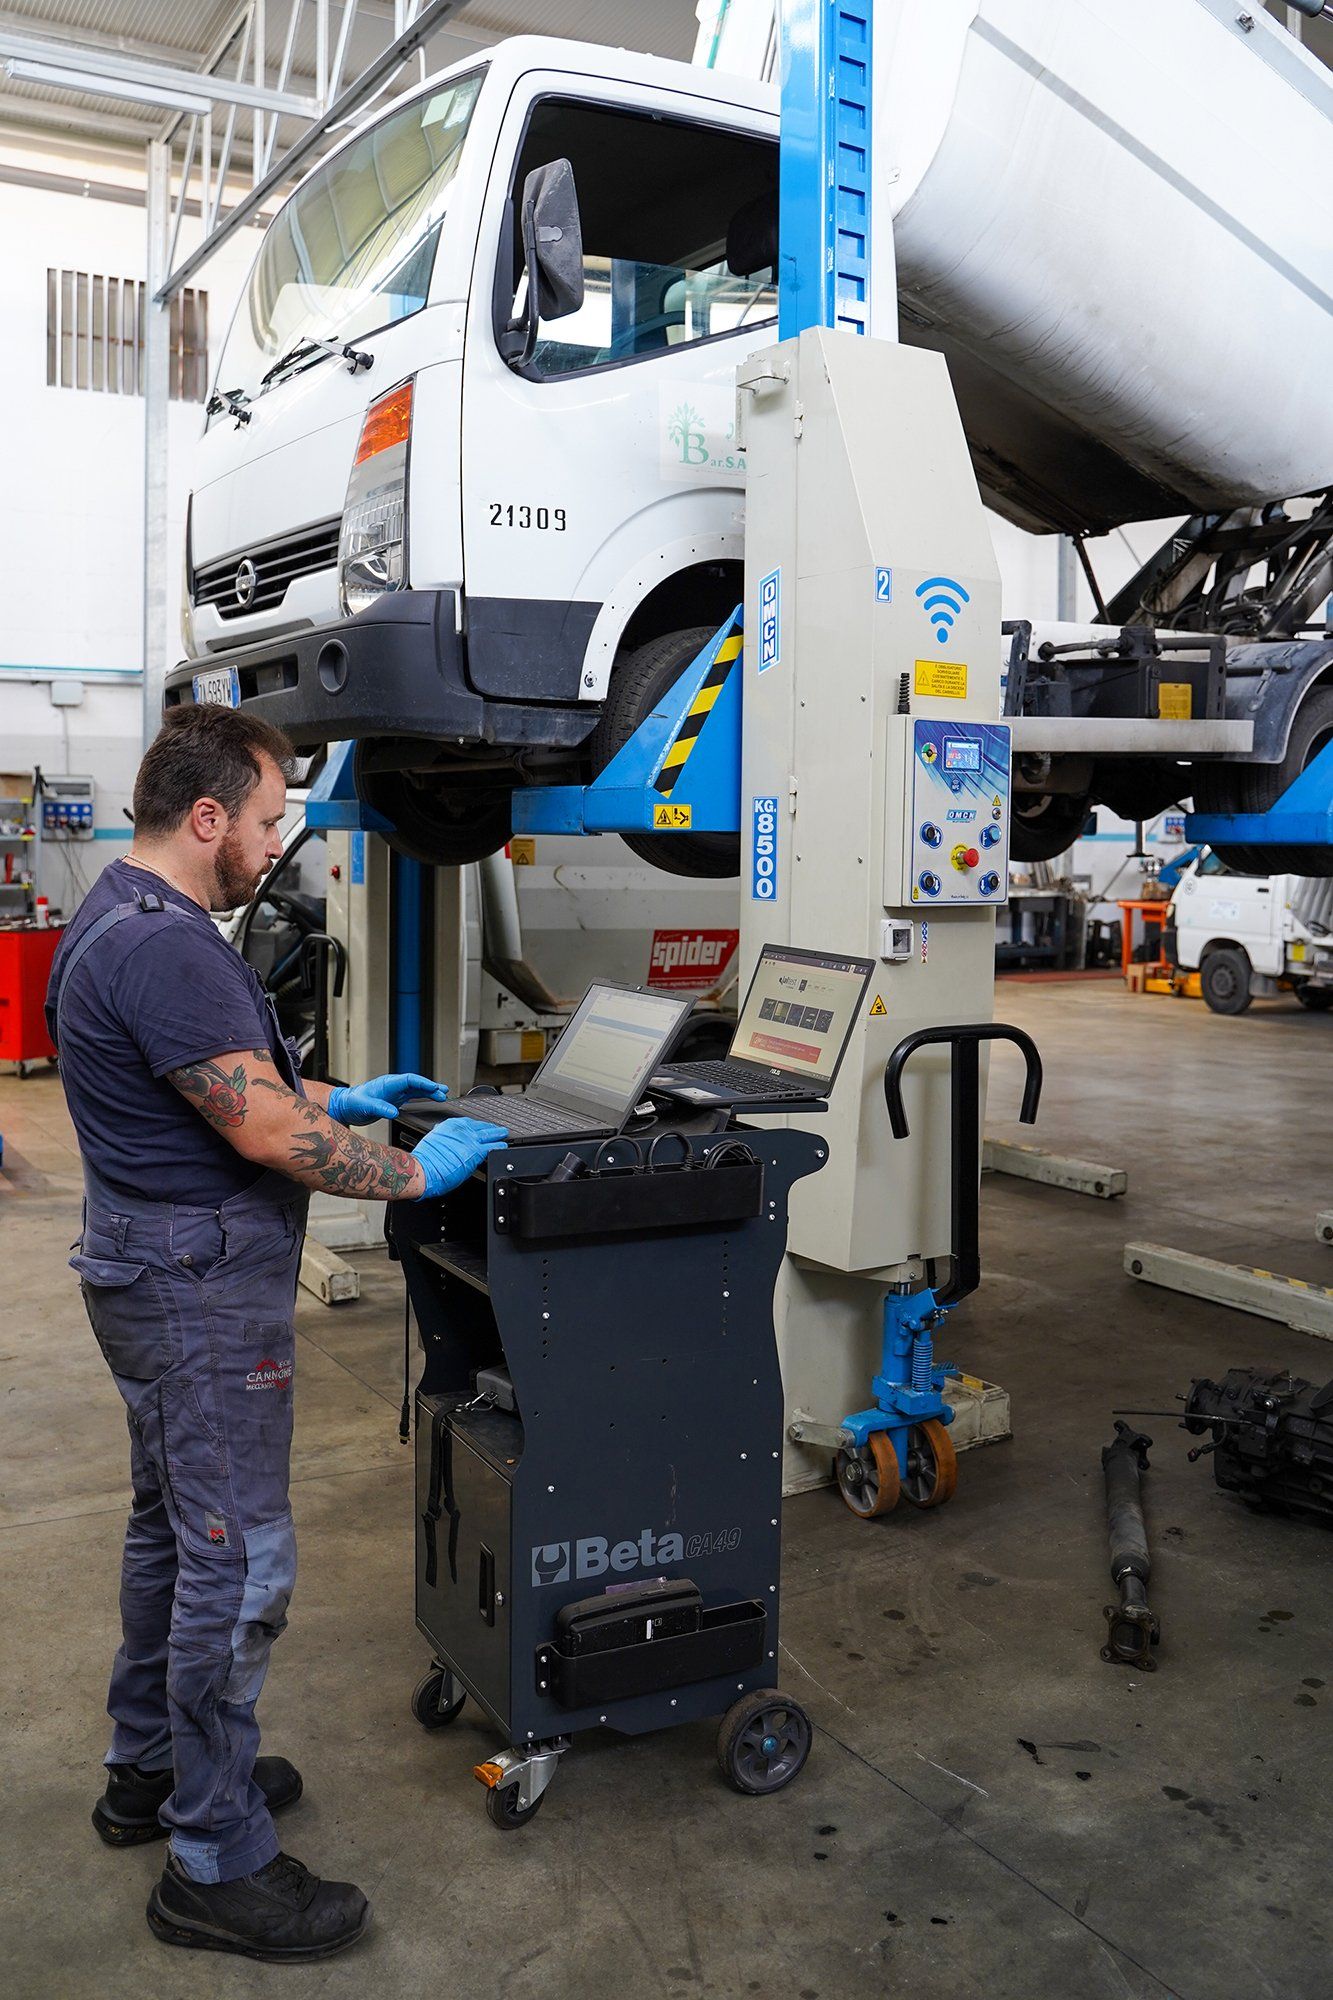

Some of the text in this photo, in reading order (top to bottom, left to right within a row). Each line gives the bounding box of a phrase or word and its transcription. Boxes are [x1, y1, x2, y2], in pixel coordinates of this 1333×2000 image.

[489, 503, 566, 531] 21309
[878, 571, 889, 600] 2
[763, 581, 776, 661] OMCN
[754, 799, 777, 813] KG.
[756, 813, 774, 898] 8500
[652, 935, 728, 973] spider
[576, 1527, 742, 1580] Beta CA49
